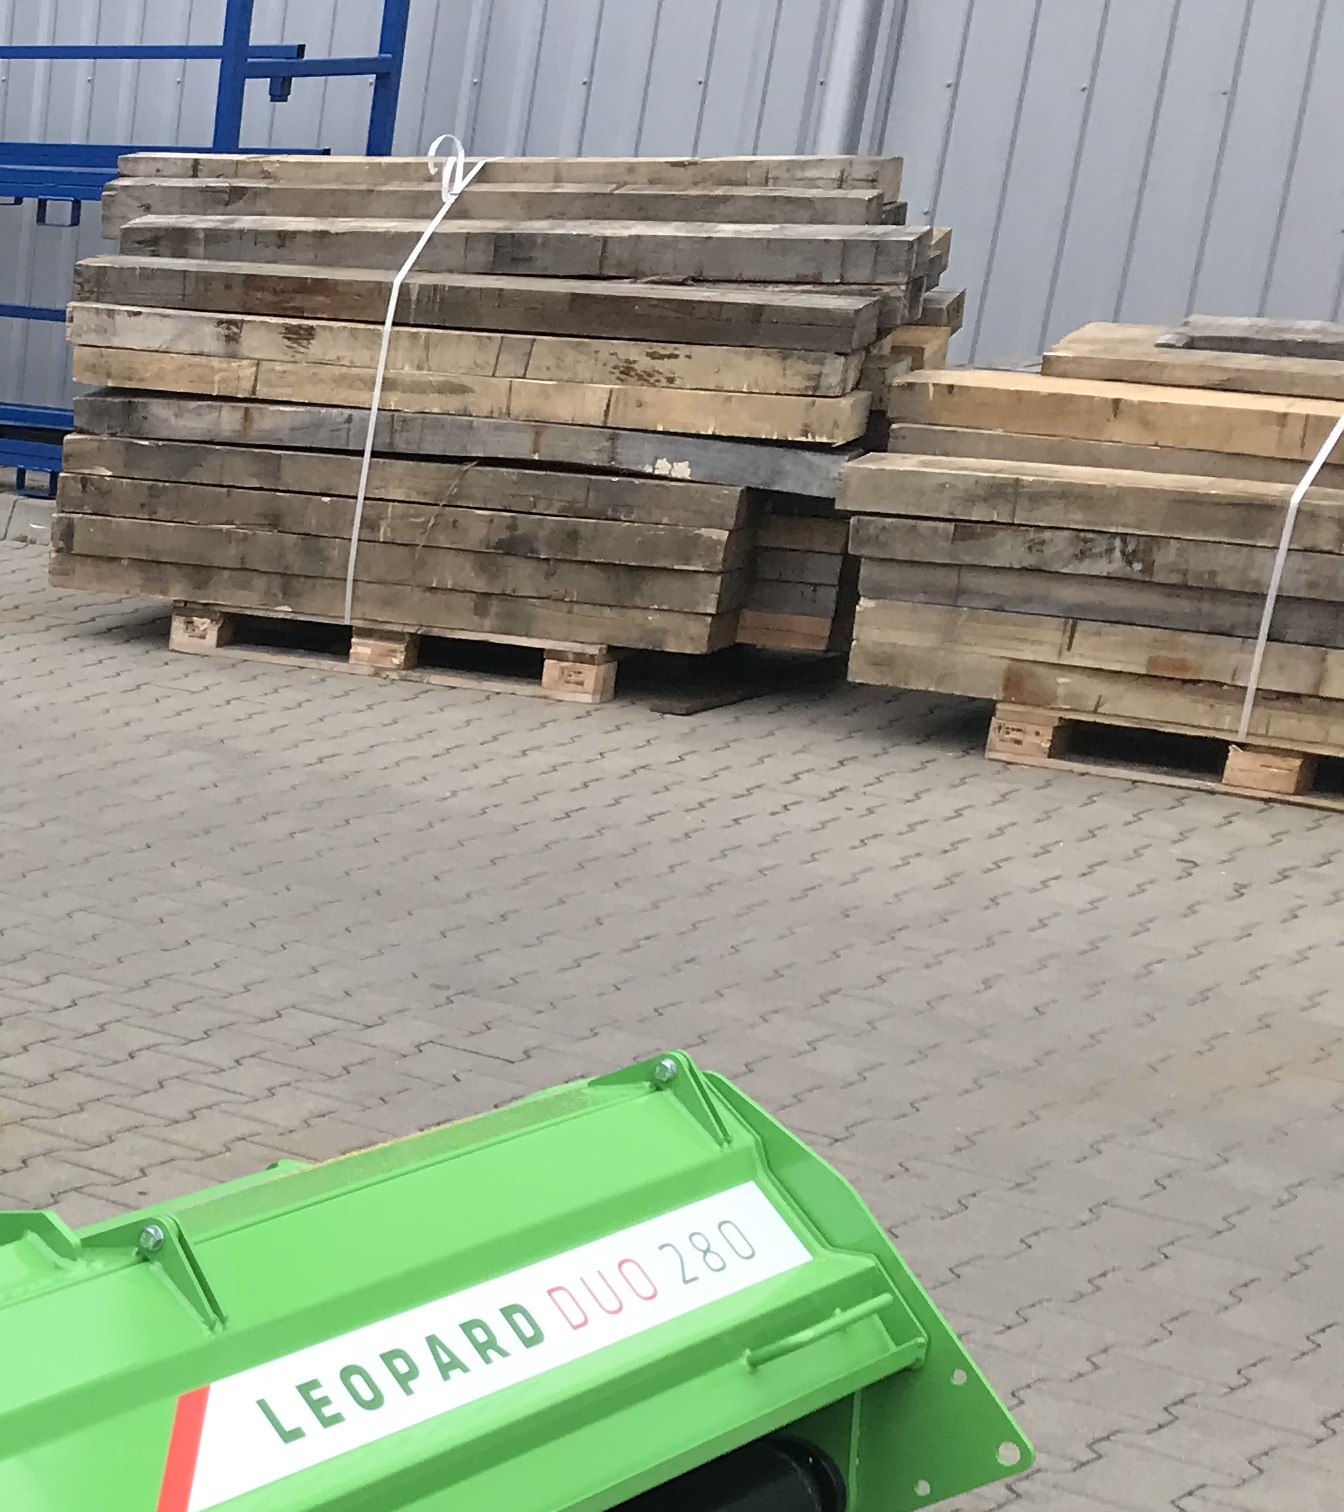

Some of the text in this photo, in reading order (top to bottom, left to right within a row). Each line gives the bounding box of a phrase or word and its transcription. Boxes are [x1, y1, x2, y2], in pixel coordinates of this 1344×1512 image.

[256, 1219, 756, 1434] LEOPARD DUO 280
